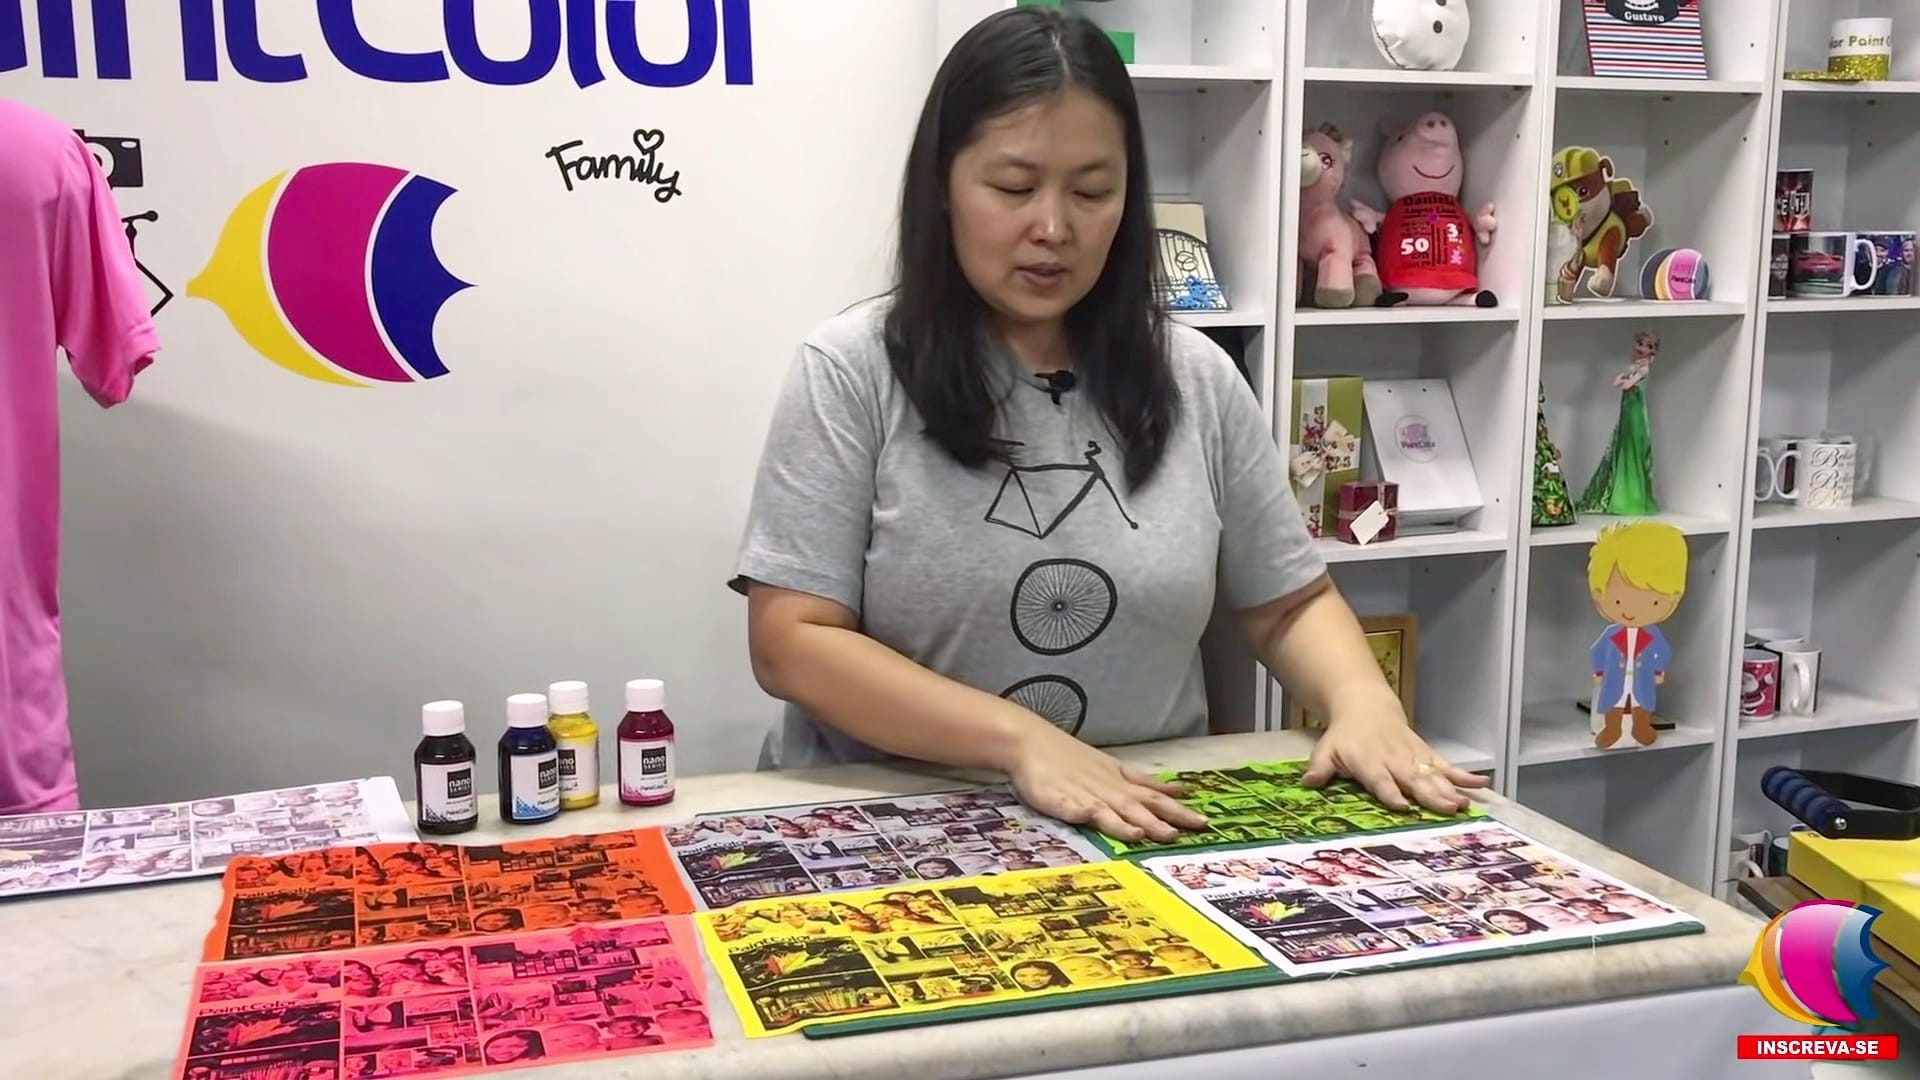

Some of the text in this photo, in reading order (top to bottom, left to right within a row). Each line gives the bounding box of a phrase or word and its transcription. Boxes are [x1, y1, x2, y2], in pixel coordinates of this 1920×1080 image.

[1624, 11, 1665, 22] Gustavo
[1849, 35, 1884, 47] Paint
[545, 129, 682, 203] Family
[1401, 237, 1430, 255] 50
[643, 755, 665, 765] nano
[449, 777, 471, 788] nano
[728, 935, 811, 953] PaintColor
[199, 1000, 296, 1016] PaintColor
